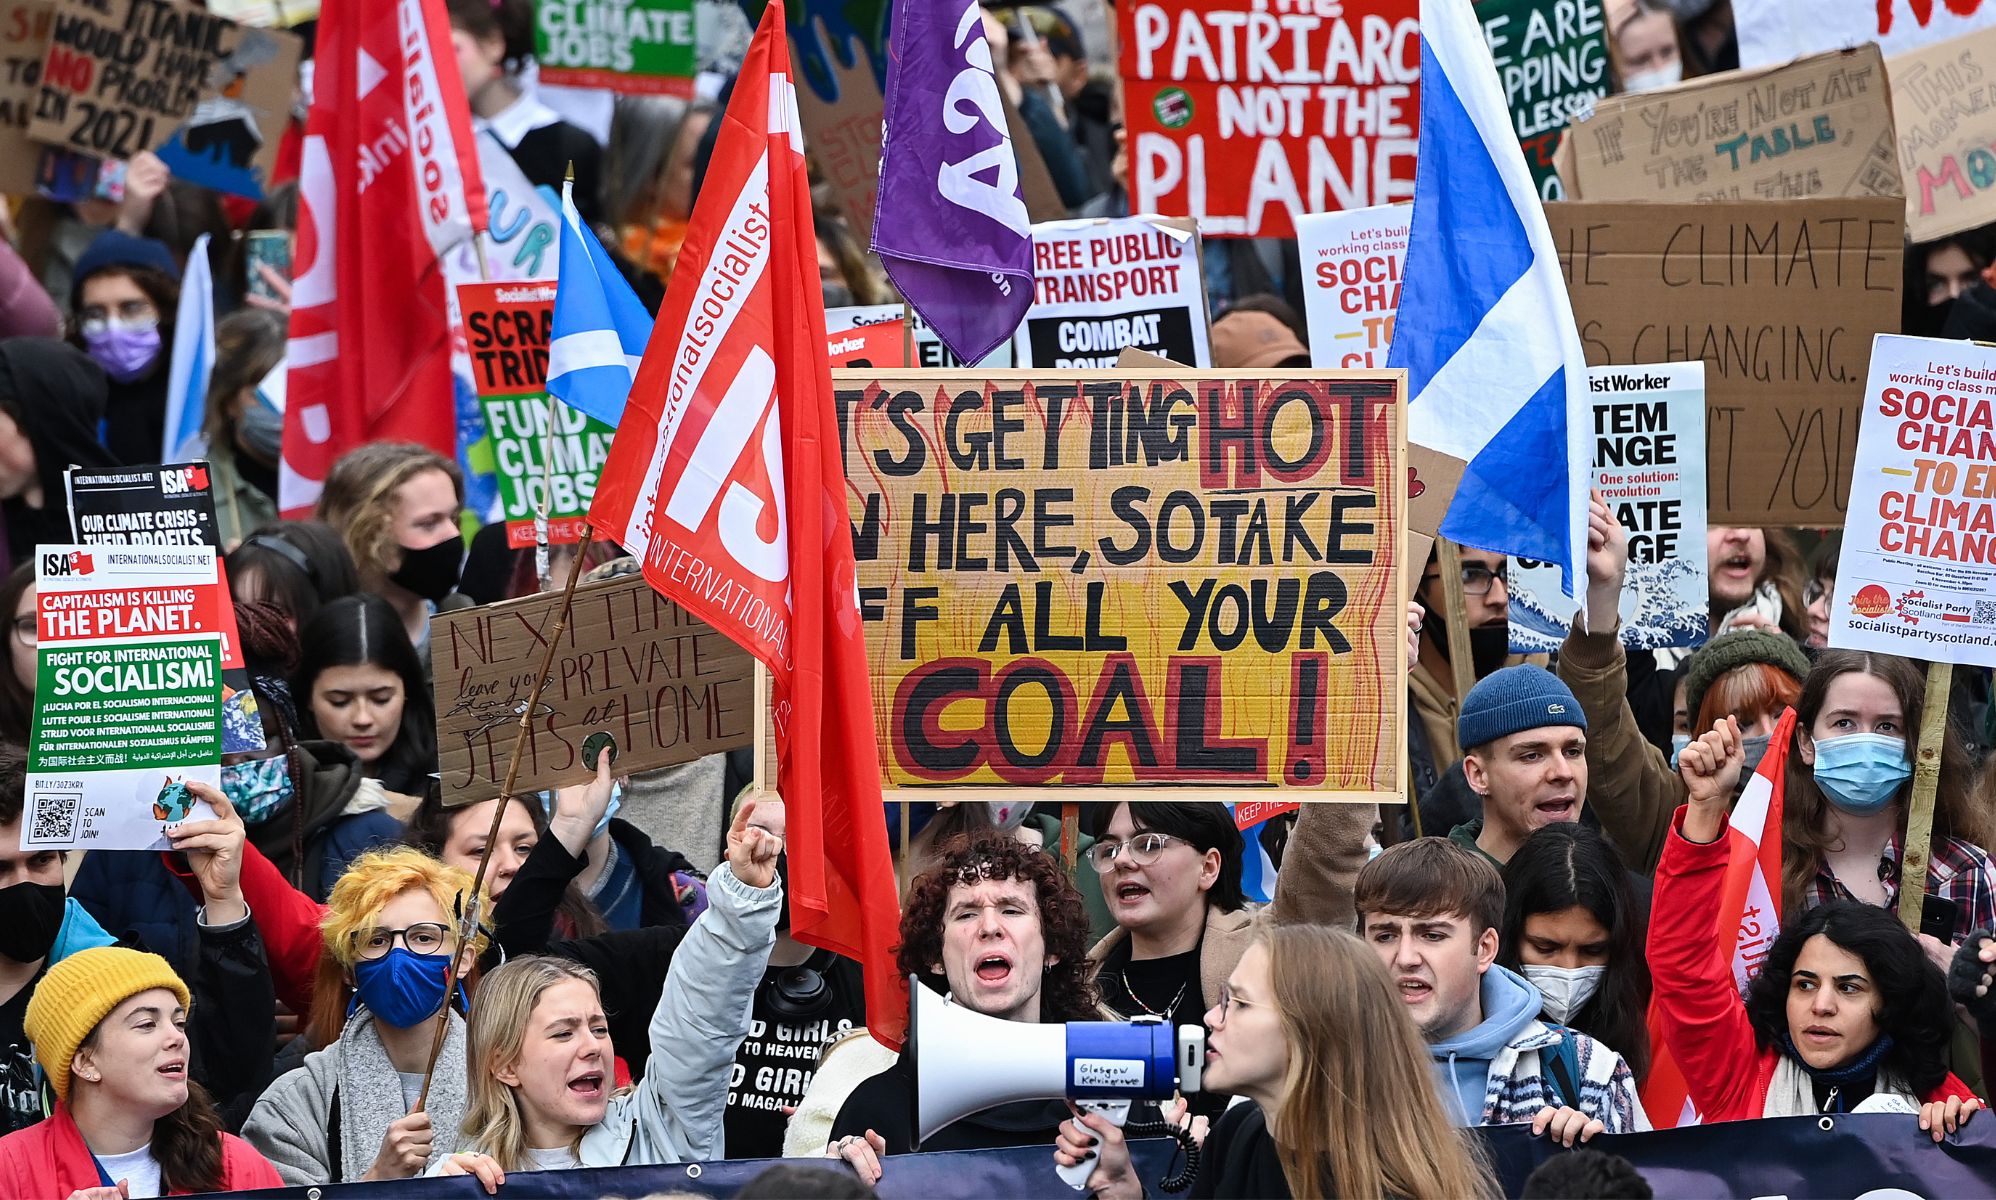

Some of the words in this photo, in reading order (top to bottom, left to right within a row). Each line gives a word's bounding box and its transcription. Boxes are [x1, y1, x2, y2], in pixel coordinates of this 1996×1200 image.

[540, 3, 693, 45] CLIMATE
[1482, 14, 1513, 67] E
[1521, 0, 1604, 57] ARE
[543, 29, 634, 72] JOBS
[1134, 4, 1420, 84] PATRIARC
[44, 43, 94, 93] NO
[1501, 39, 1607, 108] PPING
[1892, 49, 1984, 115] THIS
[36, 87, 70, 123] IN
[71, 102, 155, 160] 2021
[1217, 85, 1311, 139] NOT
[1318, 85, 1412, 138] THE
[1594, 117, 1625, 167] IF
[1747, 80, 1817, 129] NOT
[1822, 65, 1872, 106] AT
[1644, 155, 1708, 189] THE
[1755, 167, 1823, 198] THE
[1917, 150, 1996, 216] MO
[1318, 243, 1369, 257] working
[1373, 240, 1406, 251] class
[1351, 228, 1382, 241] Let's
[1662, 217, 1896, 292] CLIMATE
[1034, 265, 1181, 305] TRANSPORT
[1316, 255, 1405, 289] SOCI
[1058, 314, 1161, 353] COMBAT
[1633, 323, 1857, 384] CHANGING.
[1611, 374, 1671, 392] Worker
[1889, 373, 1944, 391] working
[1947, 380, 1982, 394] class
[1927, 362, 1961, 377] Let's
[1964, 367, 1996, 381] build
[485, 398, 588, 439] FUND
[945, 382, 1197, 471] GETTING
[1200, 380, 1396, 487] HOT
[1593, 434, 1677, 467] NGE
[74, 472, 153, 485] INTERNATIONALSOCIALIST.NET
[160, 469, 190, 494] ISA
[508, 472, 598, 517] JOBS
[1600, 473, 1623, 485] One
[1627, 472, 1679, 483] solution:
[1600, 487, 1661, 498] revolution
[81, 515, 105, 532] OUR
[105, 511, 154, 531] CLIMATE
[155, 509, 198, 529] CRISIS
[908, 488, 1091, 575] HERE,
[1098, 485, 1206, 566] SO
[1209, 492, 1377, 566] TAKE
[1612, 500, 1682, 532] ATE
[512, 526, 537, 541] KEE
[43, 554, 71, 576] ISA
[107, 554, 211, 566] INTERNATIONALSOCIALIST.NET
[43, 594, 124, 610] CAPITALISM
[128, 592, 141, 606] IS
[143, 589, 195, 605] KILLING
[650, 531, 789, 660] INTERNATIONAL
[1902, 596, 1943, 610] Socialist
[1946, 603, 1972, 616] Party
[43, 610, 91, 637] THE
[97, 604, 202, 635] PLANET.
[978, 580, 1127, 655] ALL
[1167, 571, 1353, 655] YOUR
[1902, 606, 1942, 620] Scotland
[450, 599, 584, 669] NEXT
[47, 652, 83, 666] FIGHT
[86, 650, 111, 664] FOR
[114, 645, 213, 663] INTERNATIONAL
[455, 666, 499, 701] leave
[560, 632, 721, 700] PRIVATE
[53, 659, 215, 695] SOCIALISM!
[42, 716, 67, 726] LUTTE
[68, 715, 91, 724] POUR
[93, 715, 102, 723] LE
[103, 712, 150, 723] SOCIALISME
[151, 709, 215, 721] INTERNATIONAL!
[75, 701, 91, 711] POR
[93, 701, 101, 709] EL
[103, 698, 150, 709] SOCIALISMO
[151, 694, 215, 706] INTERNACIONAL!
[583, 698, 622, 726] at
[623, 679, 745, 752] HOME
[39, 741, 55, 751] FÜR
[56, 739, 128, 750] INTERNATIONALEN
[129, 736, 179, 748] SOZIALISMUS
[180, 734, 215, 744] KÄMPFEN
[71, 728, 95, 737] VOOR
[96, 725, 165, 736] INTERNATIONAAL
[83, 819, 92, 828] TO
[85, 807, 106, 817] SCAN
[1238, 802, 1262, 823] KEEP
[80, 830, 100, 839] JOIN!
[744, 1042, 761, 1056] TO
[1080, 1063, 1128, 1079] Glasgow
[741, 1093, 799, 1112] MAGA
